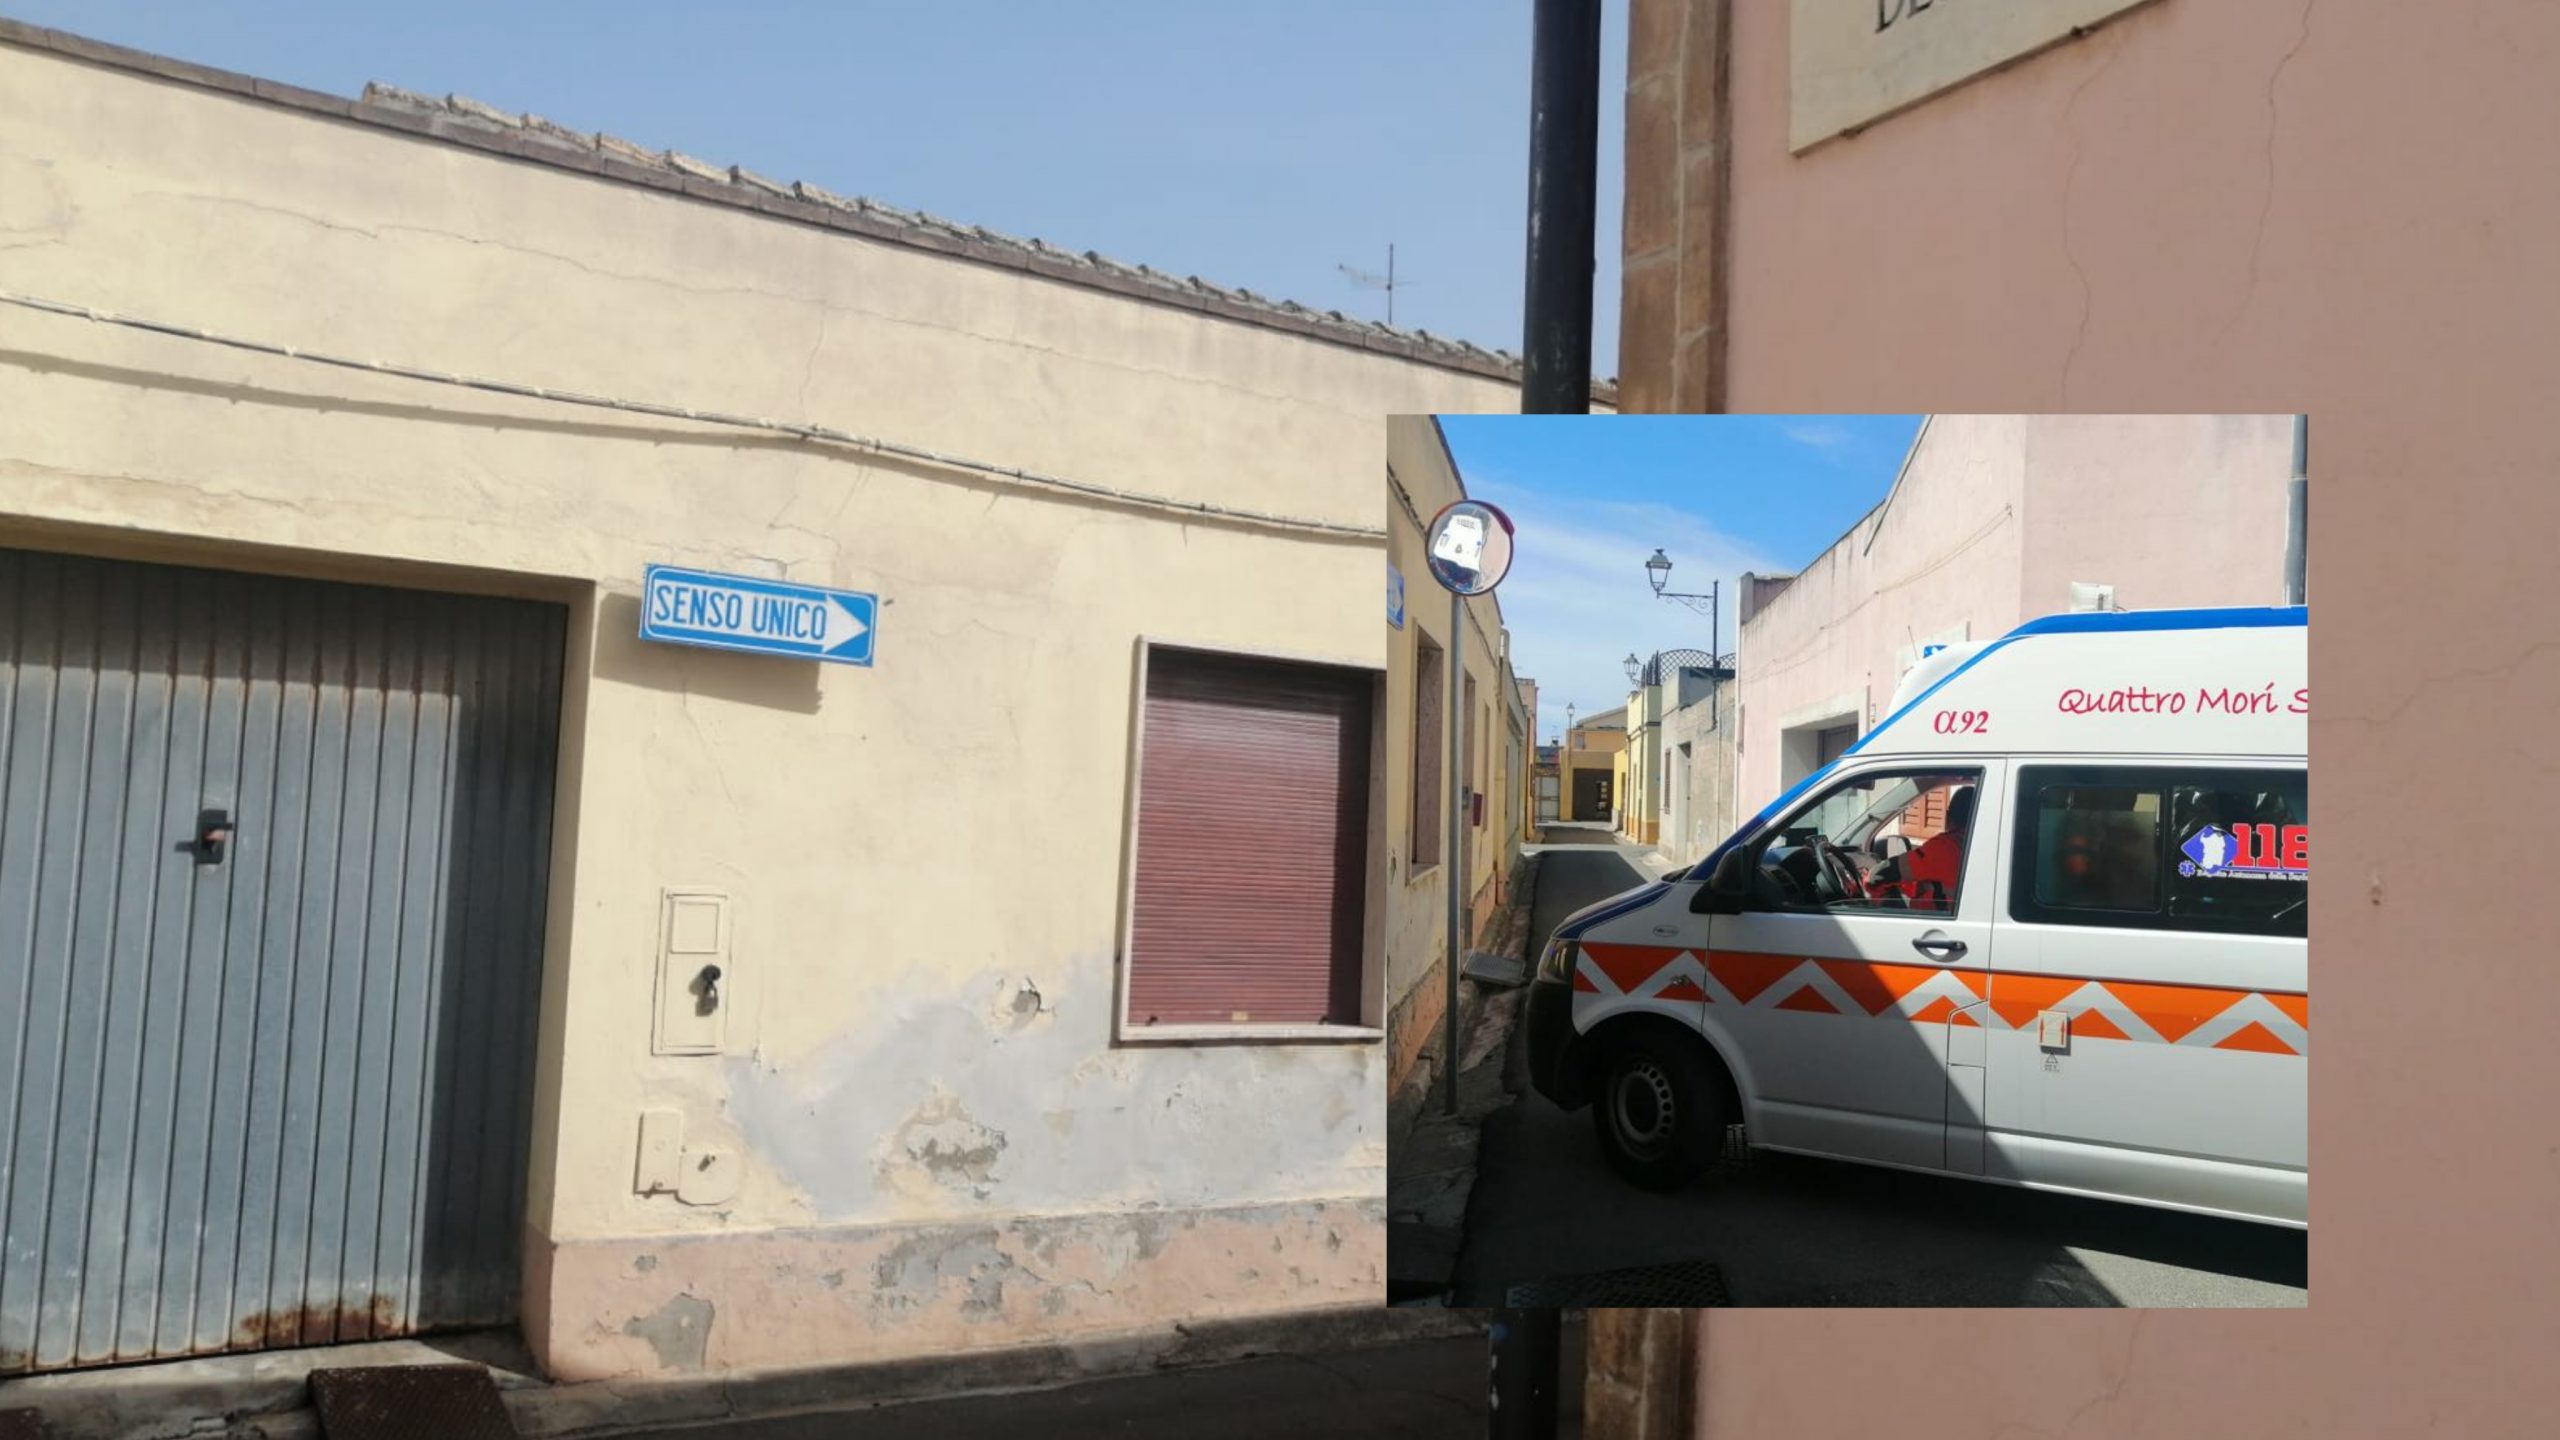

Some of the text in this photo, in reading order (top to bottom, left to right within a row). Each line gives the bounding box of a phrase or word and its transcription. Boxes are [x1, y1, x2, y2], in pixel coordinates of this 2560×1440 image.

[654, 584, 828, 641] SENSO UNICO
[2058, 686, 2186, 714] Quattro
[2196, 682, 2279, 714] Mori
[2232, 823, 2308, 869] 118
